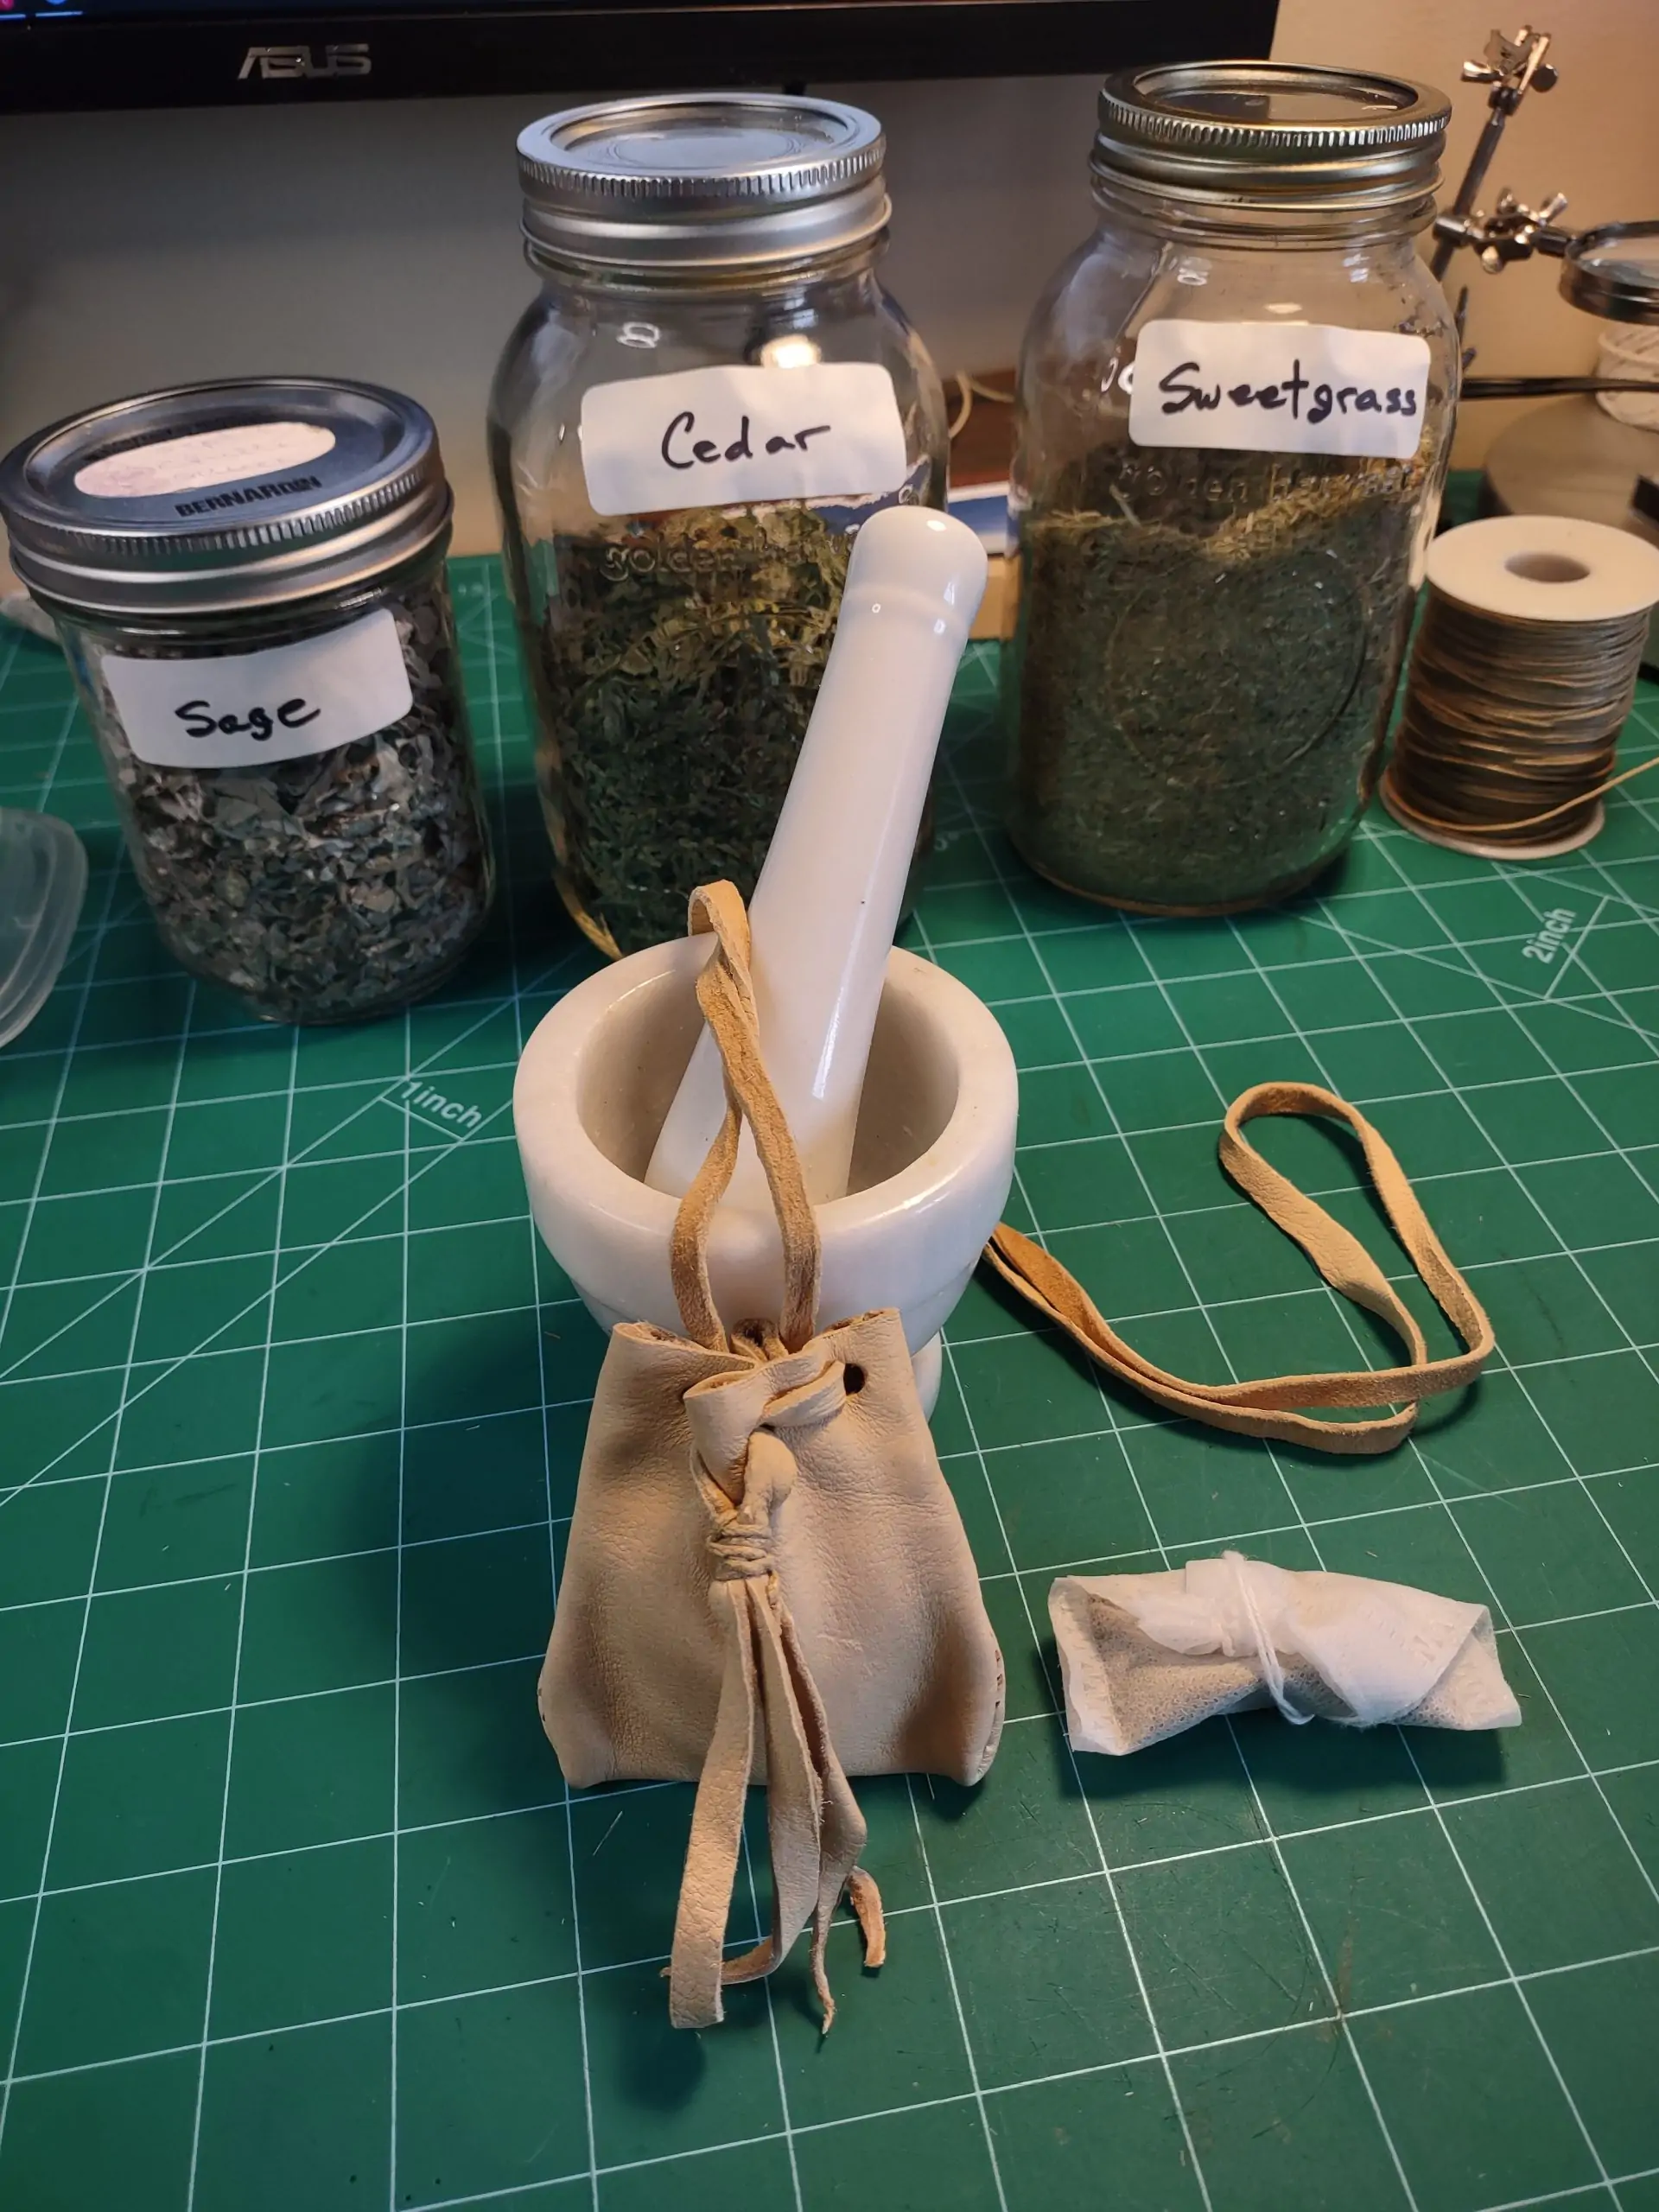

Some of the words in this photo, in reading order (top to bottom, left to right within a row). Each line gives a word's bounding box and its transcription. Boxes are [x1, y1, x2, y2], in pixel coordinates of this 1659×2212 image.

[237, 43, 372, 79] ASUS
[1158, 359, 1417, 424] Sweetgrass
[661, 410, 831, 470] Cedar
[175, 698, 321, 742] Sage
[1522, 907, 1576, 964] 2inch
[400, 1081, 482, 1128] 1inch
